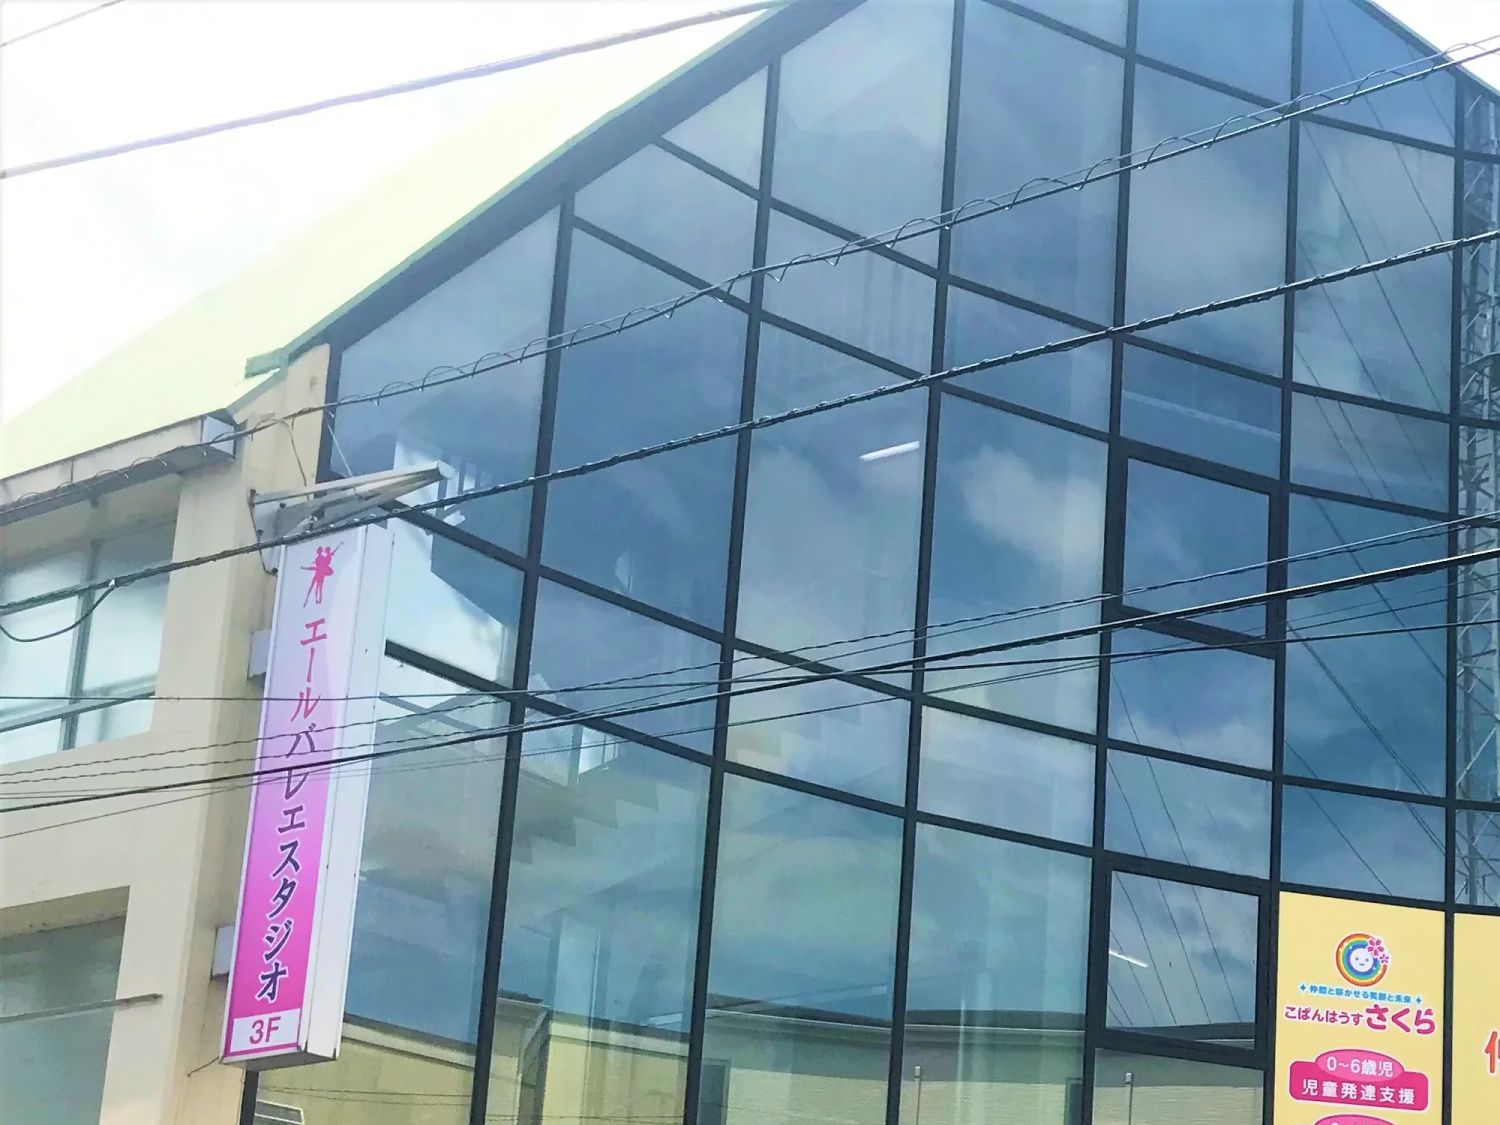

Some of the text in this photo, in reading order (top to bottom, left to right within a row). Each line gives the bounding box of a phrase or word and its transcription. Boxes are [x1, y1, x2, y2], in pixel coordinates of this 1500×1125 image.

[252, 616, 328, 1003] エールバレエスタジオ
[1309, 983, 1412, 1004] 仲間と咲かせる笑顔と未来
[249, 1017, 281, 1045] 3F
[1302, 1078, 1415, 1105] 児童発達支援
